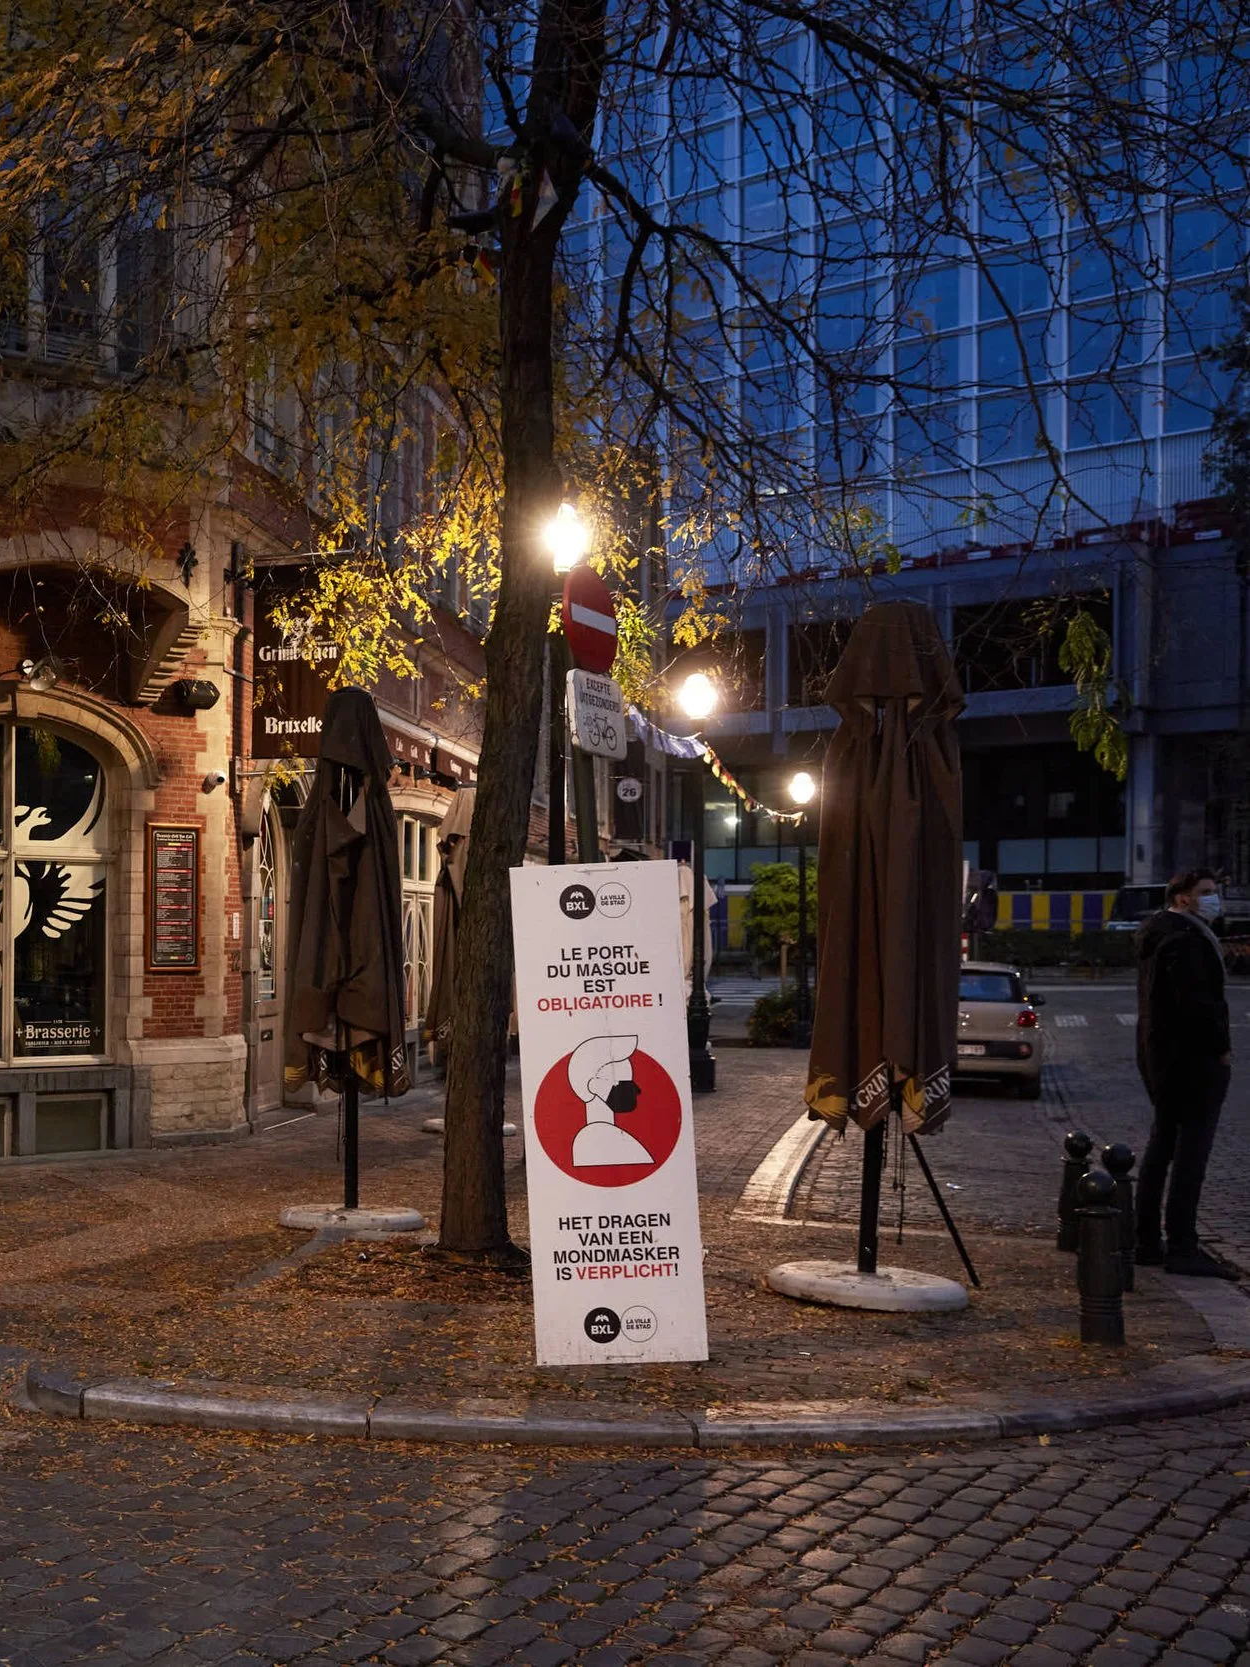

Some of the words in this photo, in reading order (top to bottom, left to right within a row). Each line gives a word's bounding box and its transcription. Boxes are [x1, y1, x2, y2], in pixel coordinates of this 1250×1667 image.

[565, 901, 590, 912] BXL
[561, 948, 582, 961] LE
[588, 945, 634, 961] PORT
[547, 964, 571, 978] DU
[577, 961, 650, 978] MASQUE
[584, 979, 616, 993] EST
[25, 1024, 91, 1039] Brasserie
[558, 1216, 593, 1230] HET
[598, 1213, 671, 1229] DRAGEN
[578, 1232, 613, 1246] VAN
[619, 1230, 653, 1245] EEN
[553, 1246, 680, 1264] MONDMASKER
[556, 1267, 572, 1281] IS
[576, 1263, 679, 1280] VERPLICHT!
[590, 1325, 615, 1335] BXL
